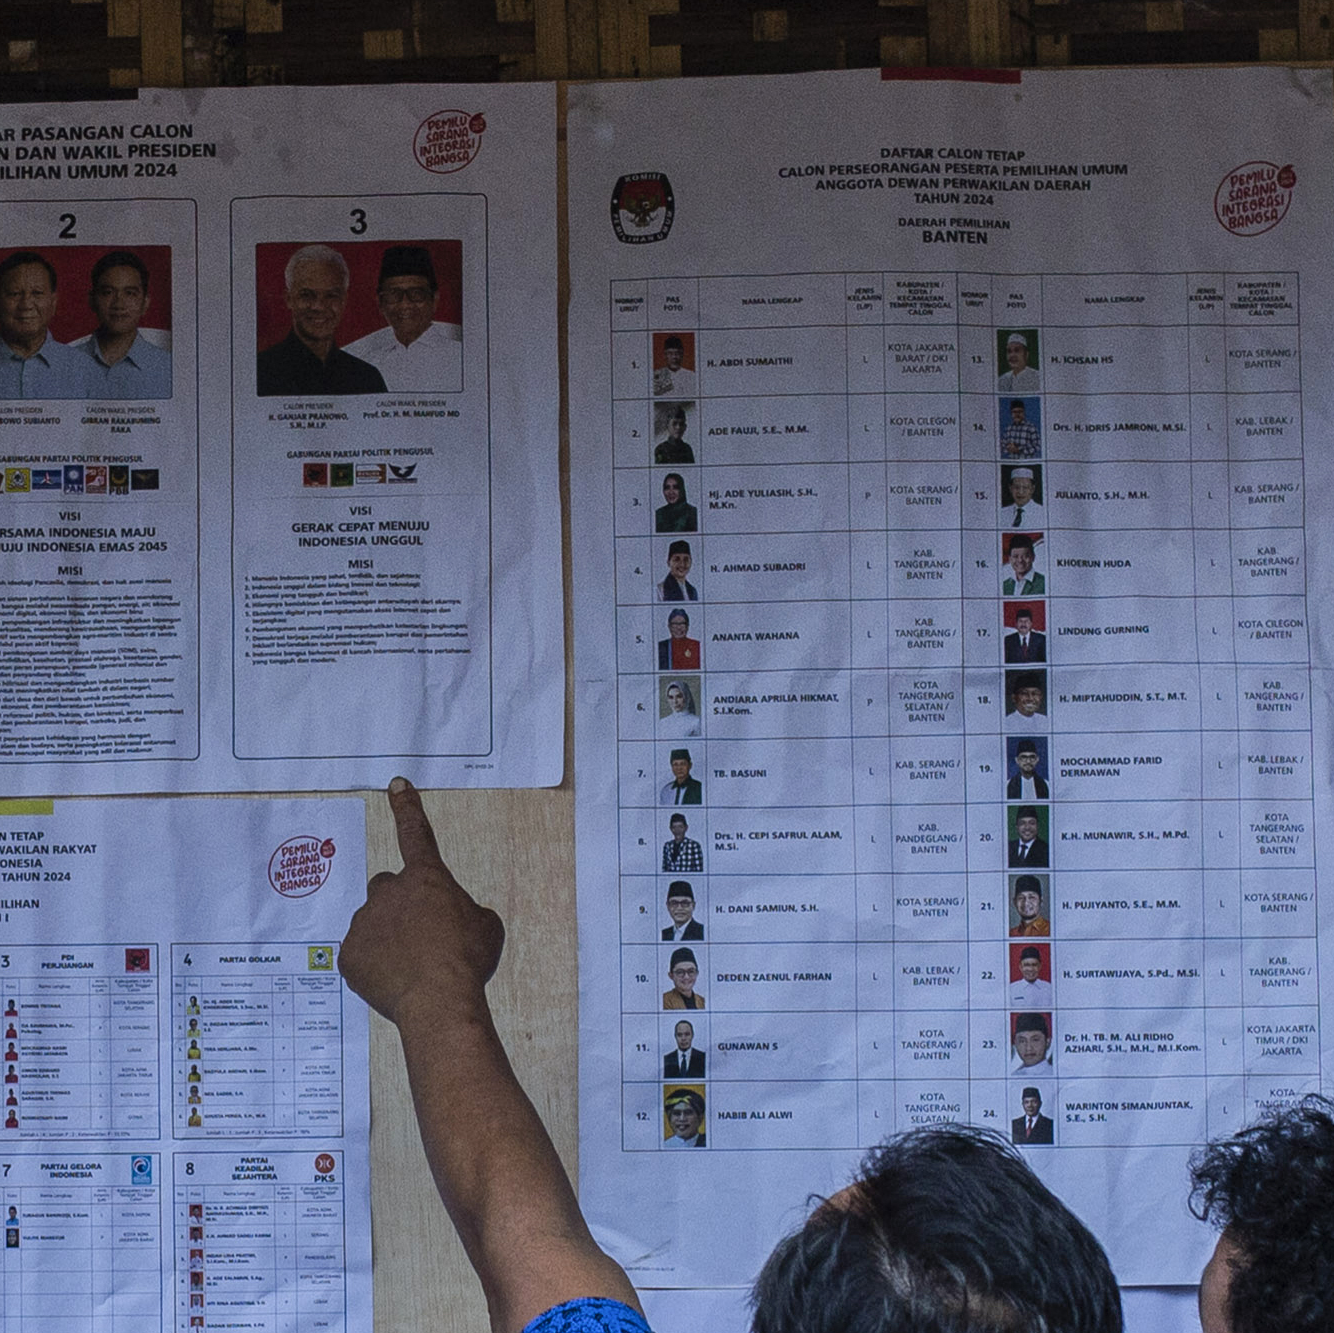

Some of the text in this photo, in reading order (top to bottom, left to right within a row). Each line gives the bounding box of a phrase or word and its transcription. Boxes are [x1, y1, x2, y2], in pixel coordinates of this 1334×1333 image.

[427, 116, 467, 131] PEMILU
[21, 125, 124, 141] PASANGAN
[130, 124, 193, 139] CALON
[426, 128, 469, 143] SARANA
[15, 146, 56, 160] DAN
[62, 145, 123, 160] WAKIL
[128, 143, 216, 158] PRESIDEN
[420, 138, 475, 157] INTEGRASI
[880, 147, 1025, 161] DAFTAR CALON TETAP
[425, 151, 470, 167] BANGSA
[67, 164, 128, 179] UMUM
[134, 163, 177, 177] 2024
[778, 165, 825, 178] CALON
[829, 162, 1128, 176] PERSEORANGAN PESERTA PEMILIHAN UMUM
[815, 178, 1091, 192] ANGGOTA DEWAN PERWAKILAN DAERAH
[1230, 169, 1275, 188] PEMILU
[1229, 182, 1277, 202] SARANA
[914, 193, 994, 205] TAHUN 2024
[1221, 193, 1285, 216] INTEGRASI
[350, 208, 367, 235] 3
[898, 217, 1010, 230] DAERAH PEMILIHAN
[1228, 209, 1279, 229] BANGSA
[59, 213, 76, 239] 2
[923, 230, 988, 244] BANTEN
[59, 512, 81, 521] VISI
[349, 506, 372, 516] VISI
[49, 527, 117, 538] INDONESIA
[121, 527, 156, 537] MAJU
[291, 521, 430, 533] GERAK CEPAT MENUJU
[27, 542, 95, 553] INDONESIA
[99, 542, 135, 552] EMAS
[138, 542, 167, 551] 2045
[299, 535, 423, 547] INDONESIA UNGGUL
[348, 559, 373, 569] MISI
[58, 566, 83, 576] MISI
[712, 632, 799, 641] ANANTA WAHANA
[1058, 625, 1149, 636] LINDUNG GURNING
[1060, 756, 1162, 766] MOCHAMMAD FARID
[1060, 769, 1120, 777] DERMAWAN
[10, 831, 45, 841] TETAP
[52, 844, 97, 854] RAKYAT
[282, 843, 318, 857] PEMILU
[280, 853, 319, 868] SARANA
[1, 872, 41, 882] TAHUN
[43, 872, 71, 882] 2024
[275, 863, 325, 881] INTEGRASI
[280, 876, 320, 891] BANGSA
[728, 905, 753, 913] DANI
[5, 913, 9, 922] I
[1, 955, 10, 968] 3
[183, 953, 192, 966] 4
[717, 973, 832, 982] DEDEN ZAENUL FARHAN
[717, 1042, 778, 1051] GUNAWAN S
[1066, 1102, 1119, 1111] WARINTON
[718, 1111, 747, 1120] HABIB
[750, 1111, 765, 1119] ALI
[2, 1164, 11, 1177] 7
[185, 1162, 195, 1176] 8
[315, 1175, 337, 1183] PKS
